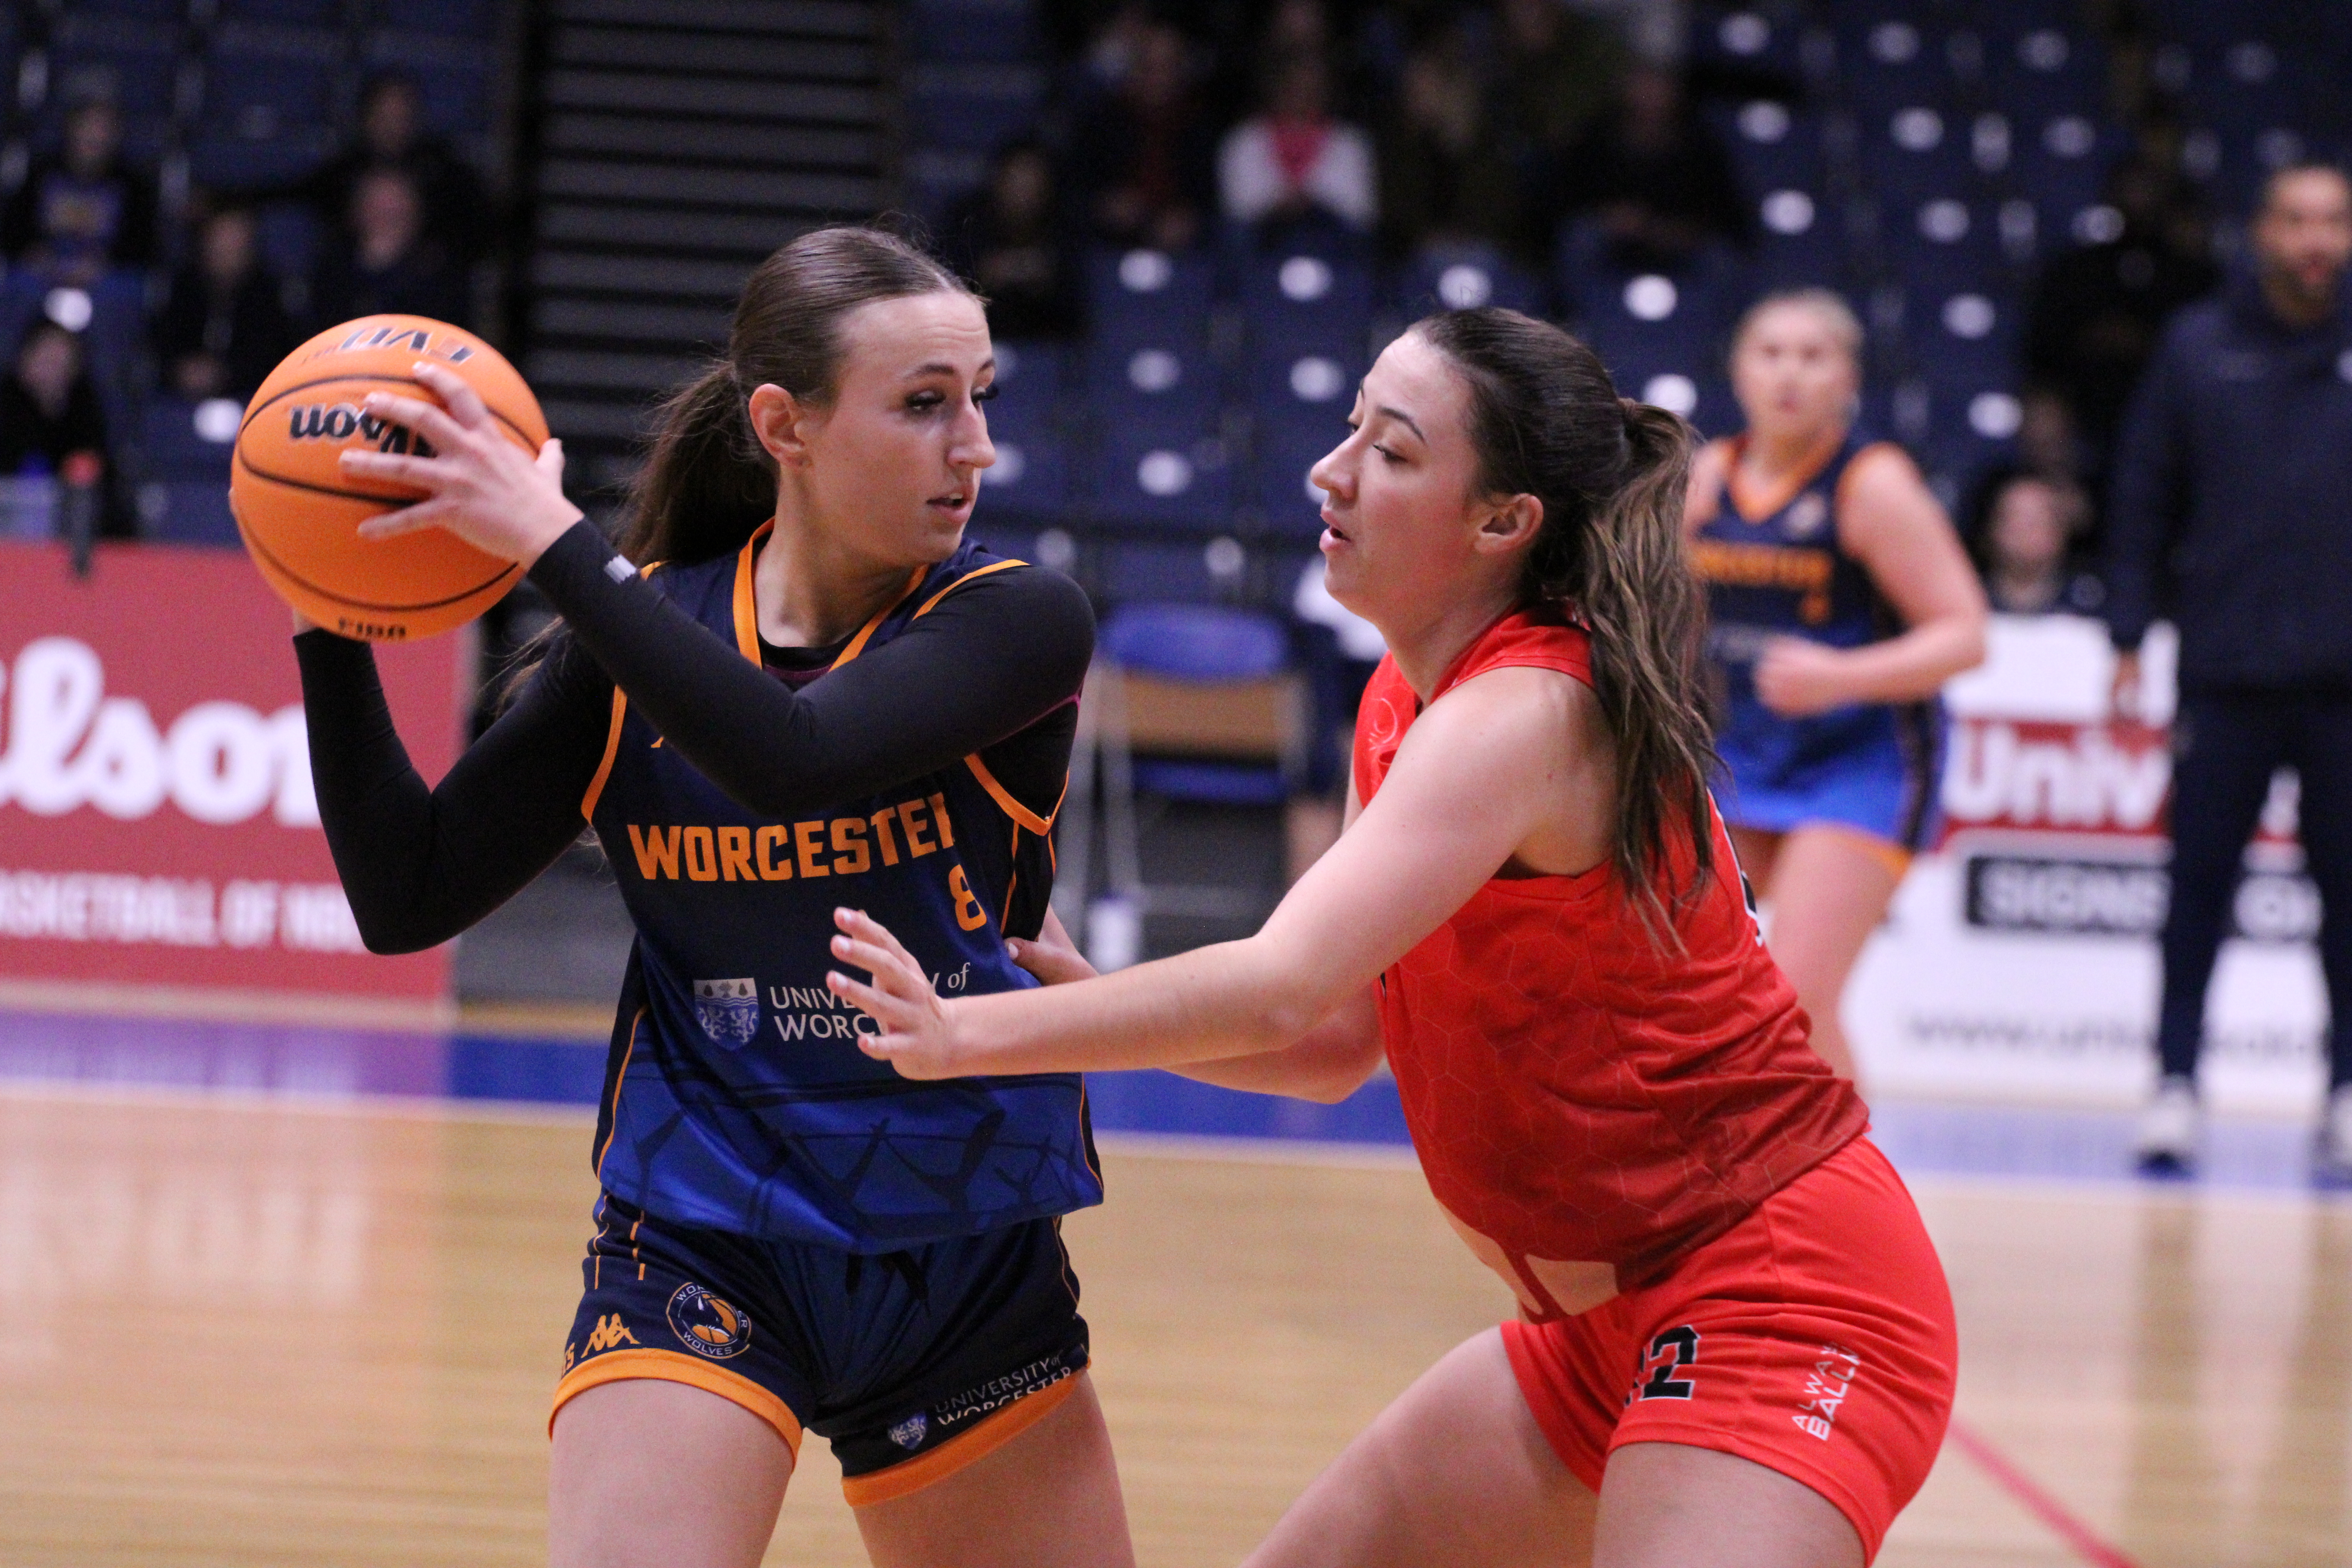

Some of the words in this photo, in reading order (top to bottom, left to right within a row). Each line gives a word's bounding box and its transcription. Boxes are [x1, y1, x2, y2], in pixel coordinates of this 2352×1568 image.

[948, 864, 987, 931] 8
[947, 962, 970, 991] of
[684, 1332, 732, 1355] WOLVES
[935, 1357, 1050, 1413] UNIVERSITY
